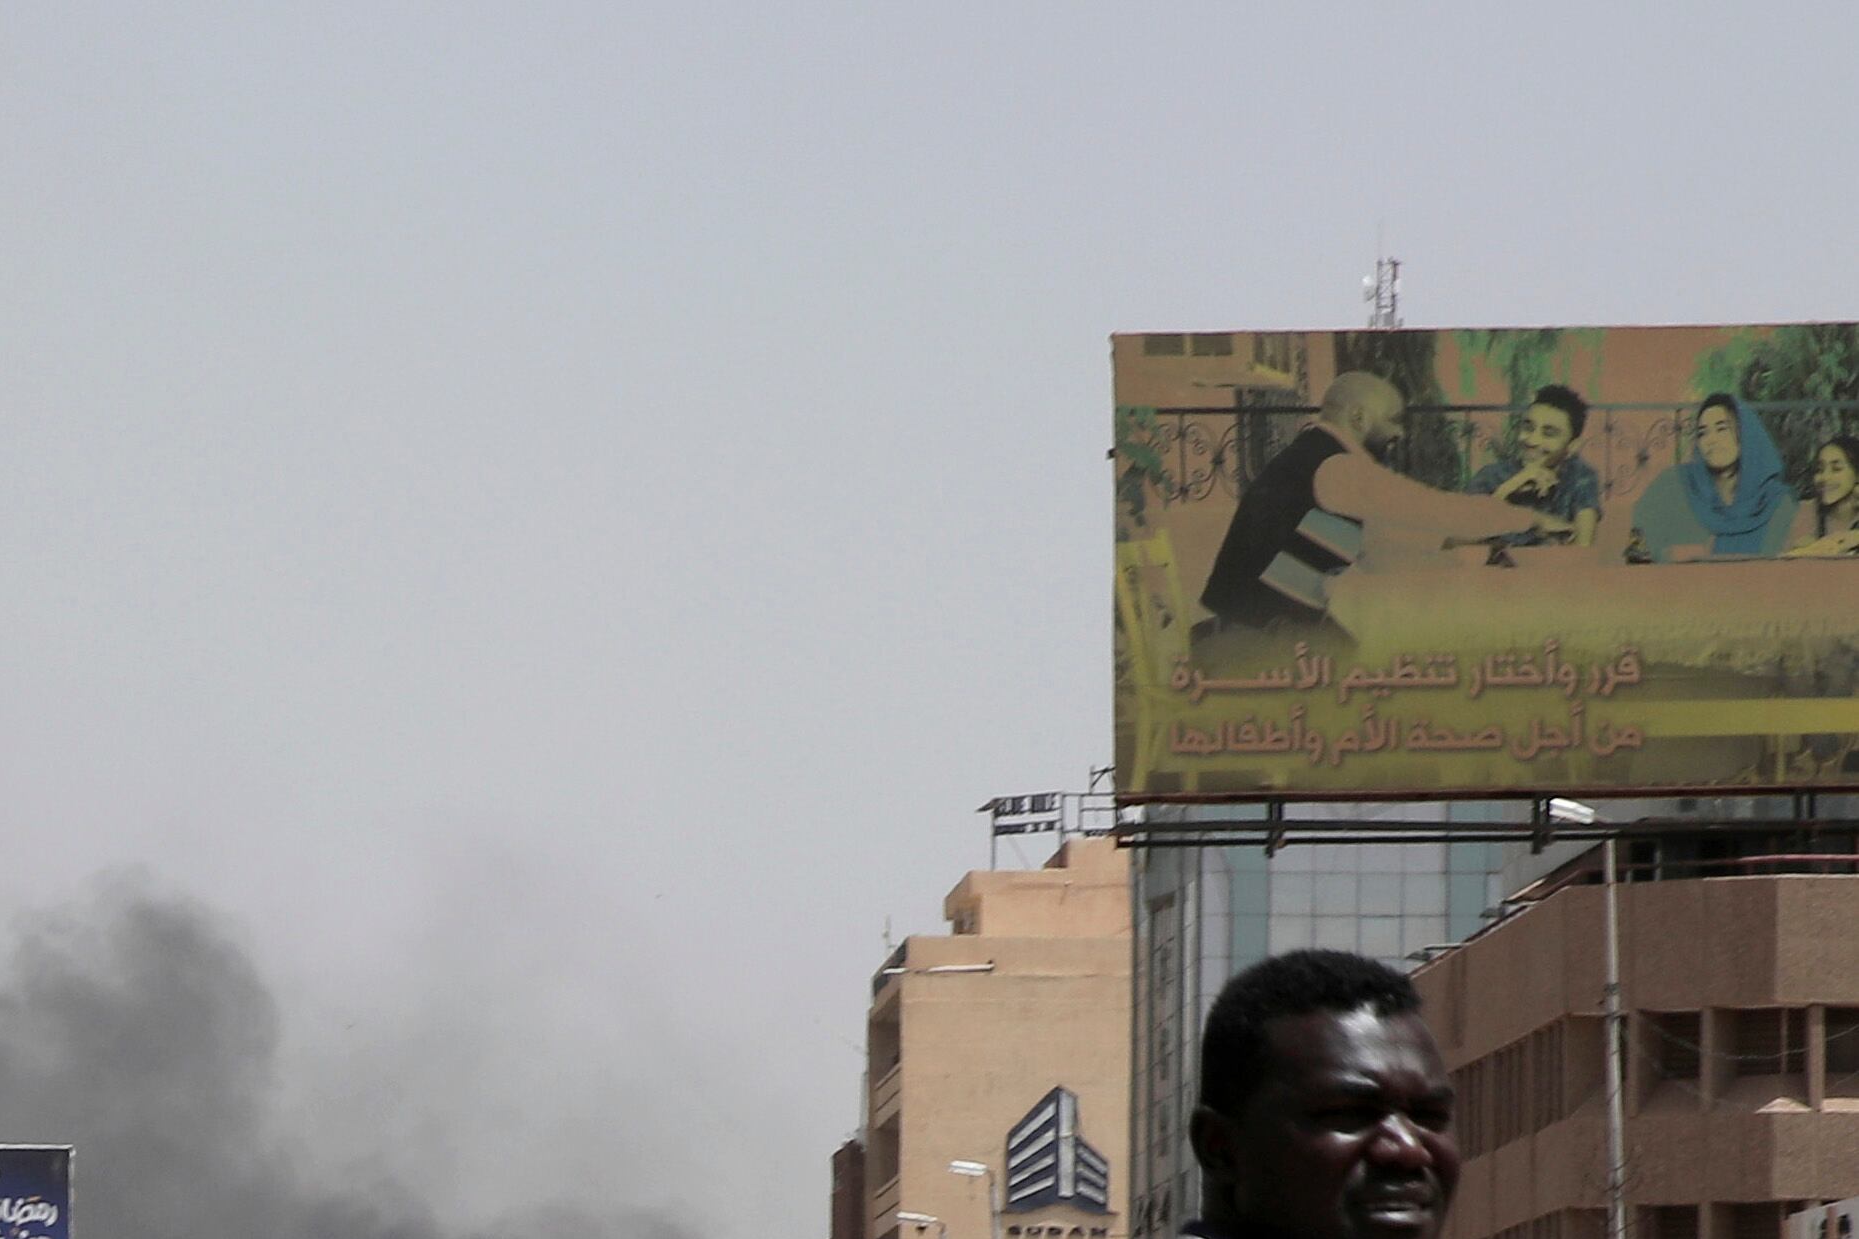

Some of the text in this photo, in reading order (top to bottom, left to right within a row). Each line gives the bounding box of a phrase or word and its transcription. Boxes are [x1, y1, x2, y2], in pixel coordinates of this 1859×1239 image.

[1169, 639, 1641, 704] قرر وأختار تنظيم الأسرة
[1168, 703, 1642, 767] من أجل صحة الأم وأطفالها
